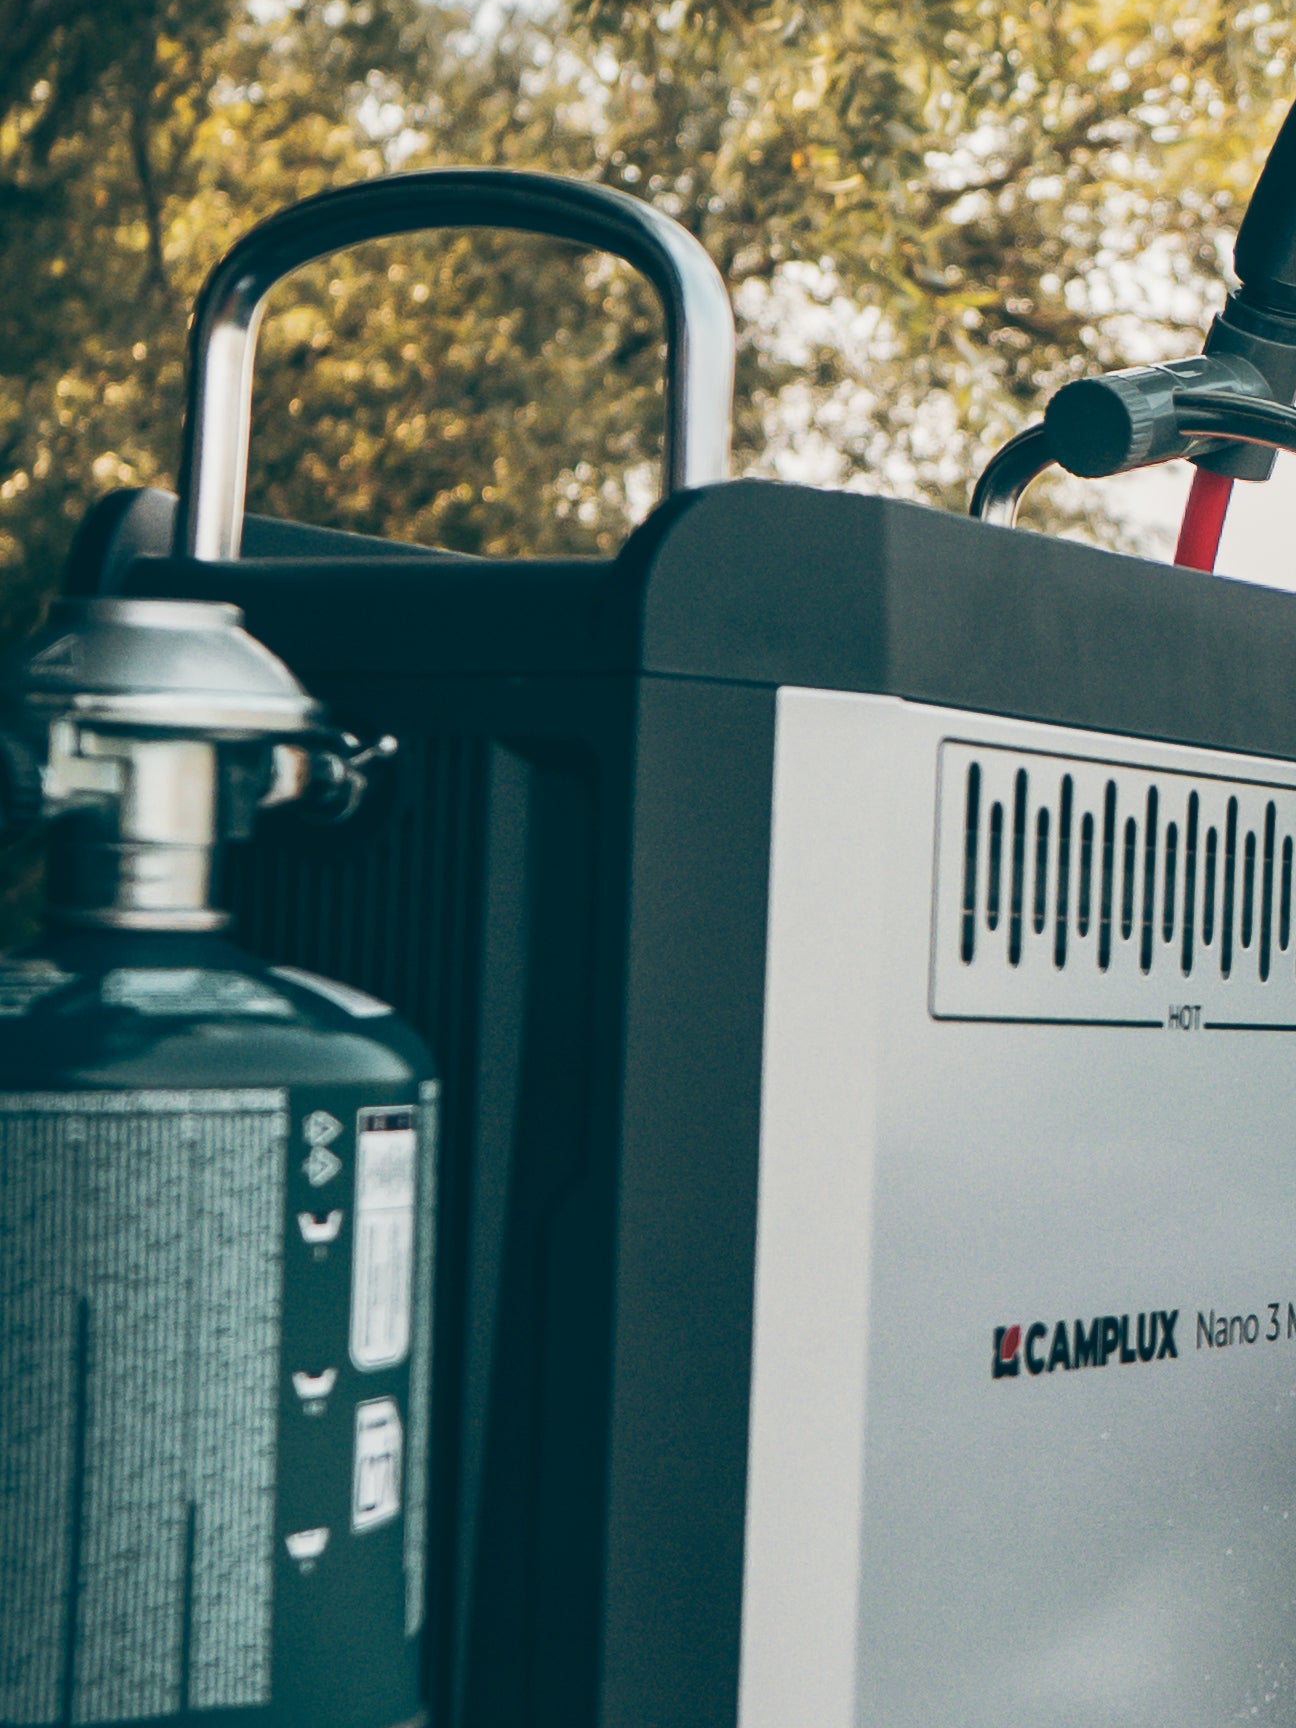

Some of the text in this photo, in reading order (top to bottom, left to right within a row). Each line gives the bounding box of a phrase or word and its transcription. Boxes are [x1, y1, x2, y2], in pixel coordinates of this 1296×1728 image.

[1168, 1004, 1202, 1031] HOT
[1024, 1309, 1180, 1376] CAMPLUX
[1196, 1309, 1260, 1350] Nano
[1266, 1303, 1281, 1342] 3
